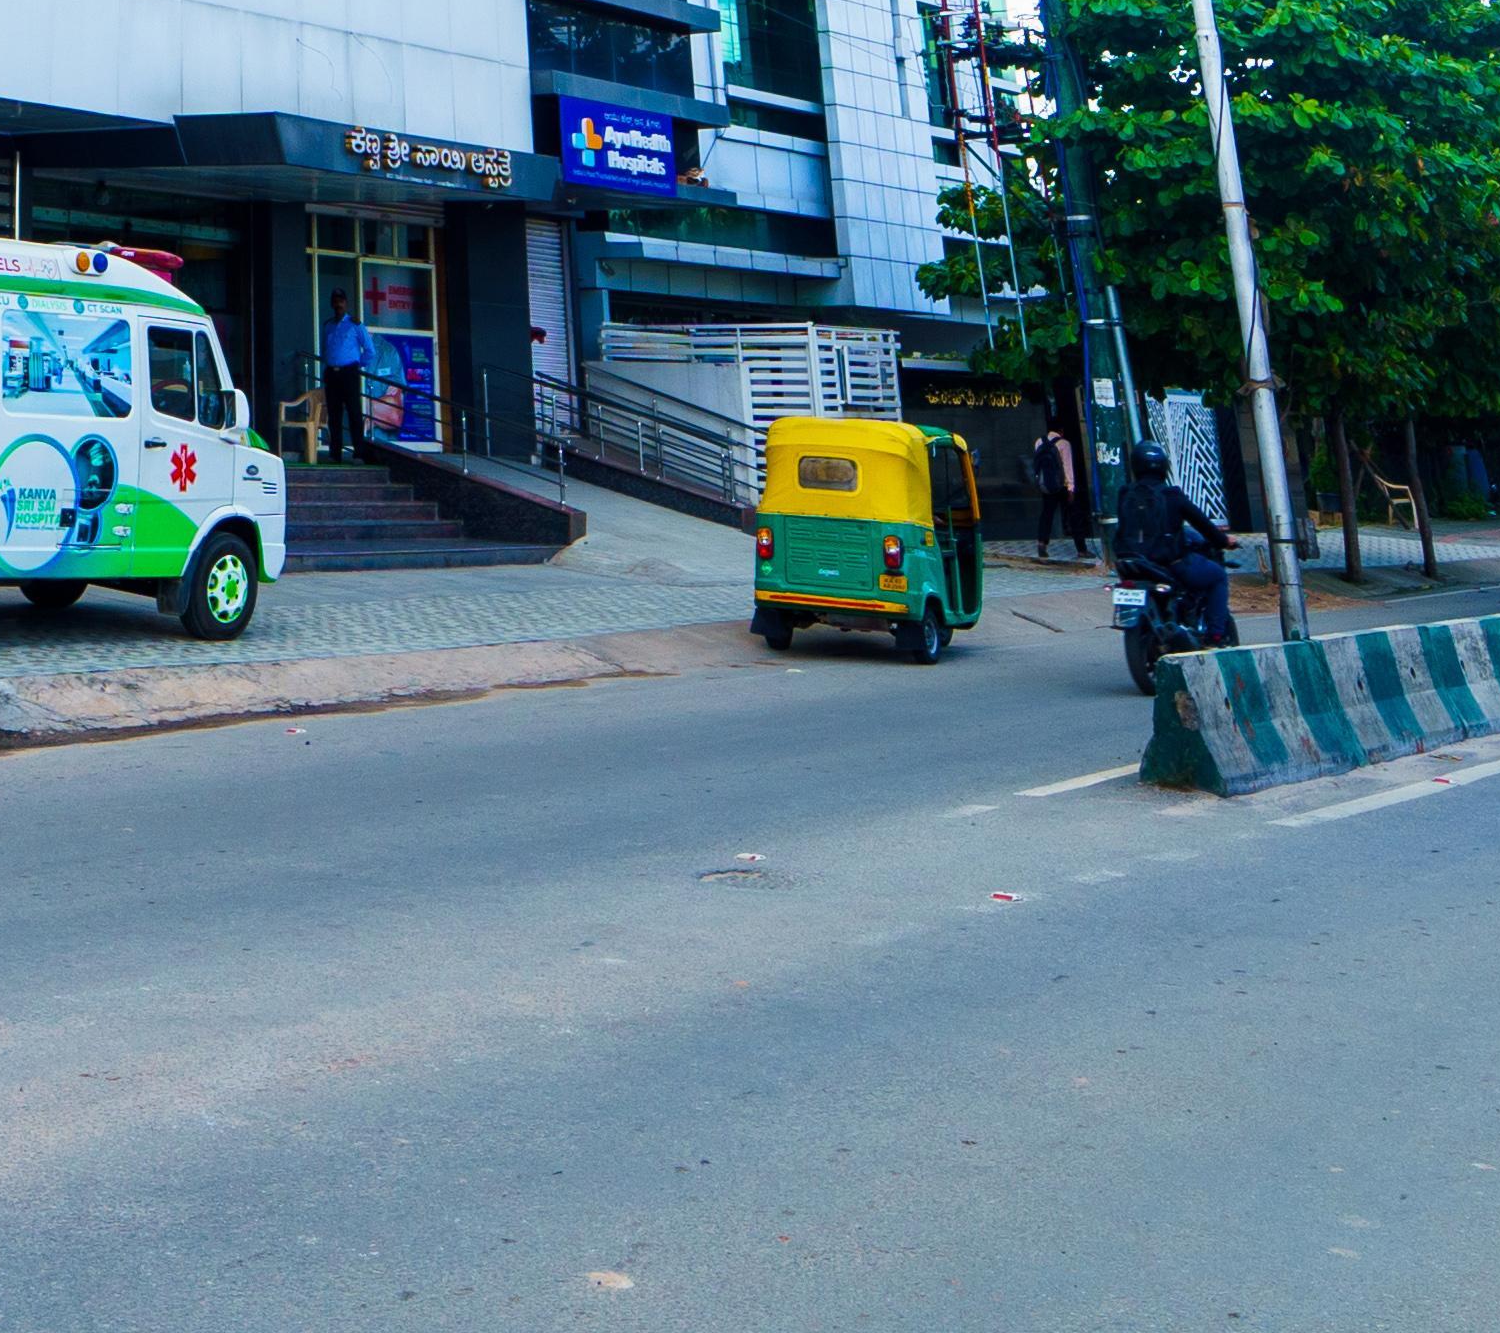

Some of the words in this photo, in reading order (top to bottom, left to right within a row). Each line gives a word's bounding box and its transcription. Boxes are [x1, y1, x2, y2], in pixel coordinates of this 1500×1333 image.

[604, 126, 672, 153] AyuHealth
[412, 144, 466, 171] ಸಾಯಿ
[607, 150, 666, 175] Hospitals
[32, 298, 68, 311] DIALYSIS
[87, 303, 98, 314] CT
[100, 304, 123, 315] SCAN
[18, 487, 57, 501] KANVA
[16, 499, 34, 512] SRI
[38, 500, 56, 513] SAI
